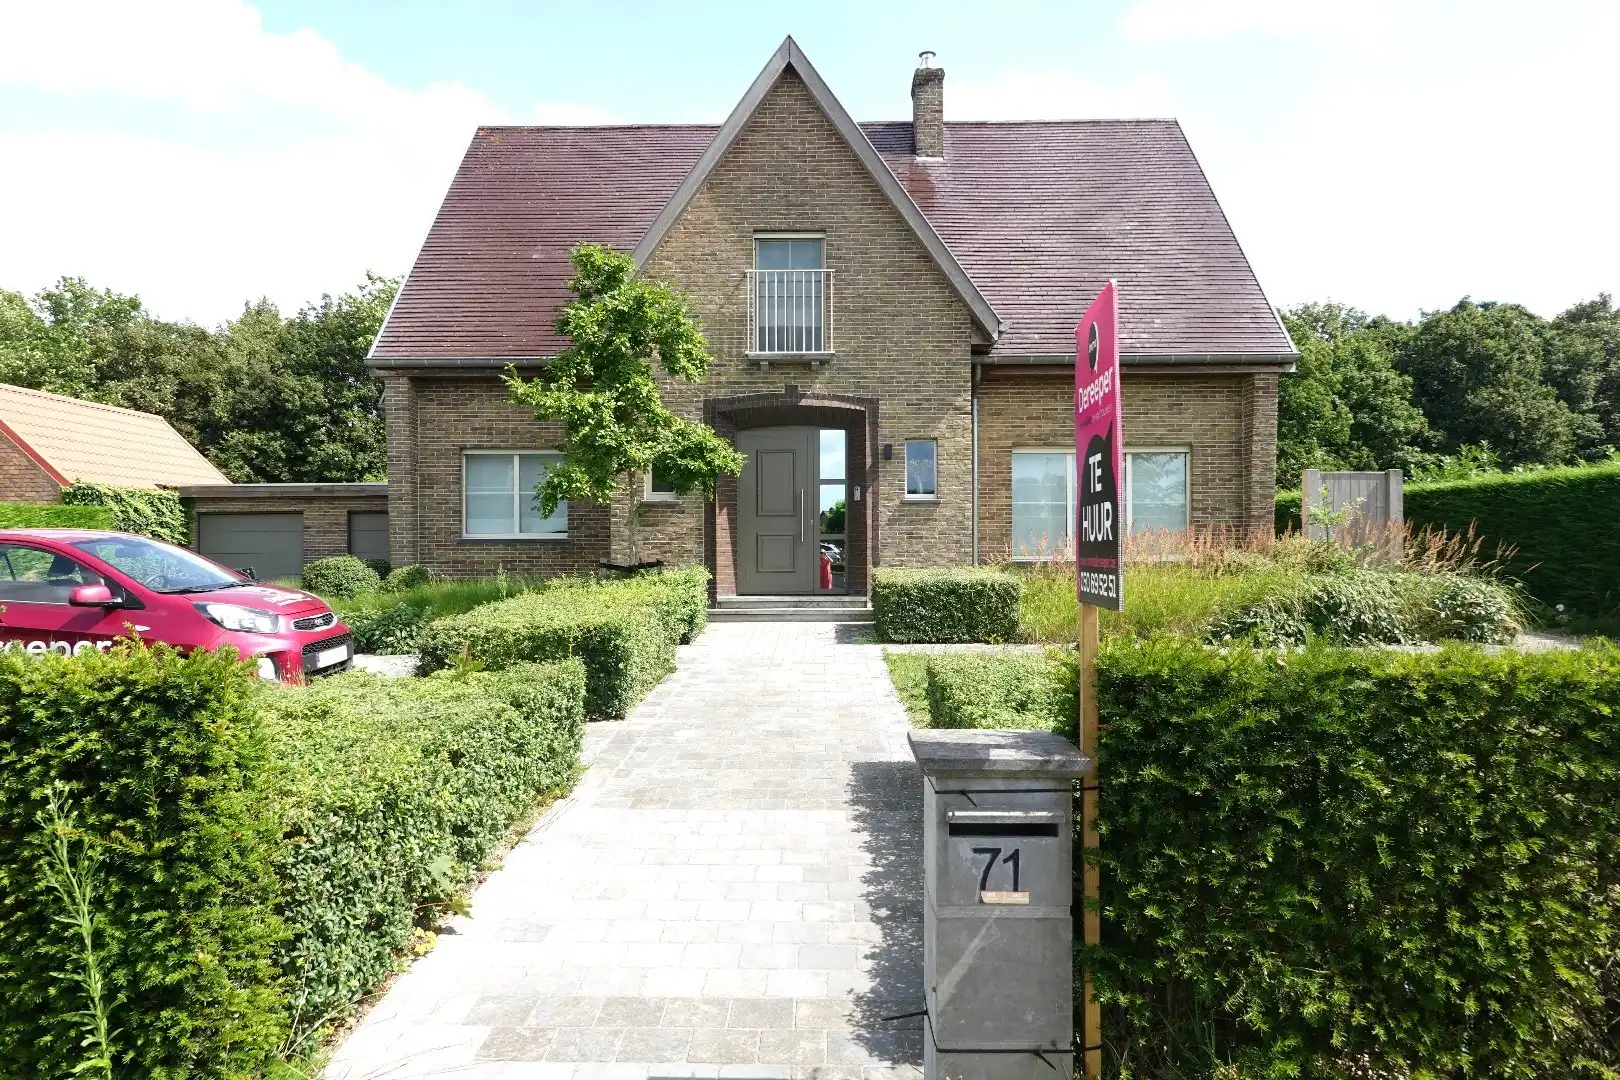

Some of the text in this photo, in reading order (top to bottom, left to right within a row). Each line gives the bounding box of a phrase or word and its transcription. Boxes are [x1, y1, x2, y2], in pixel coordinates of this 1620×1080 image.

[1078, 366, 1114, 413] Dereeper
[1088, 452, 1102, 494] TE
[1082, 501, 1113, 542] HUUR
[1090, 572, 1099, 595] 69
[1099, 573, 1108, 597] 52
[1108, 574, 1117, 598] 51
[971, 847, 1020, 903] 71
